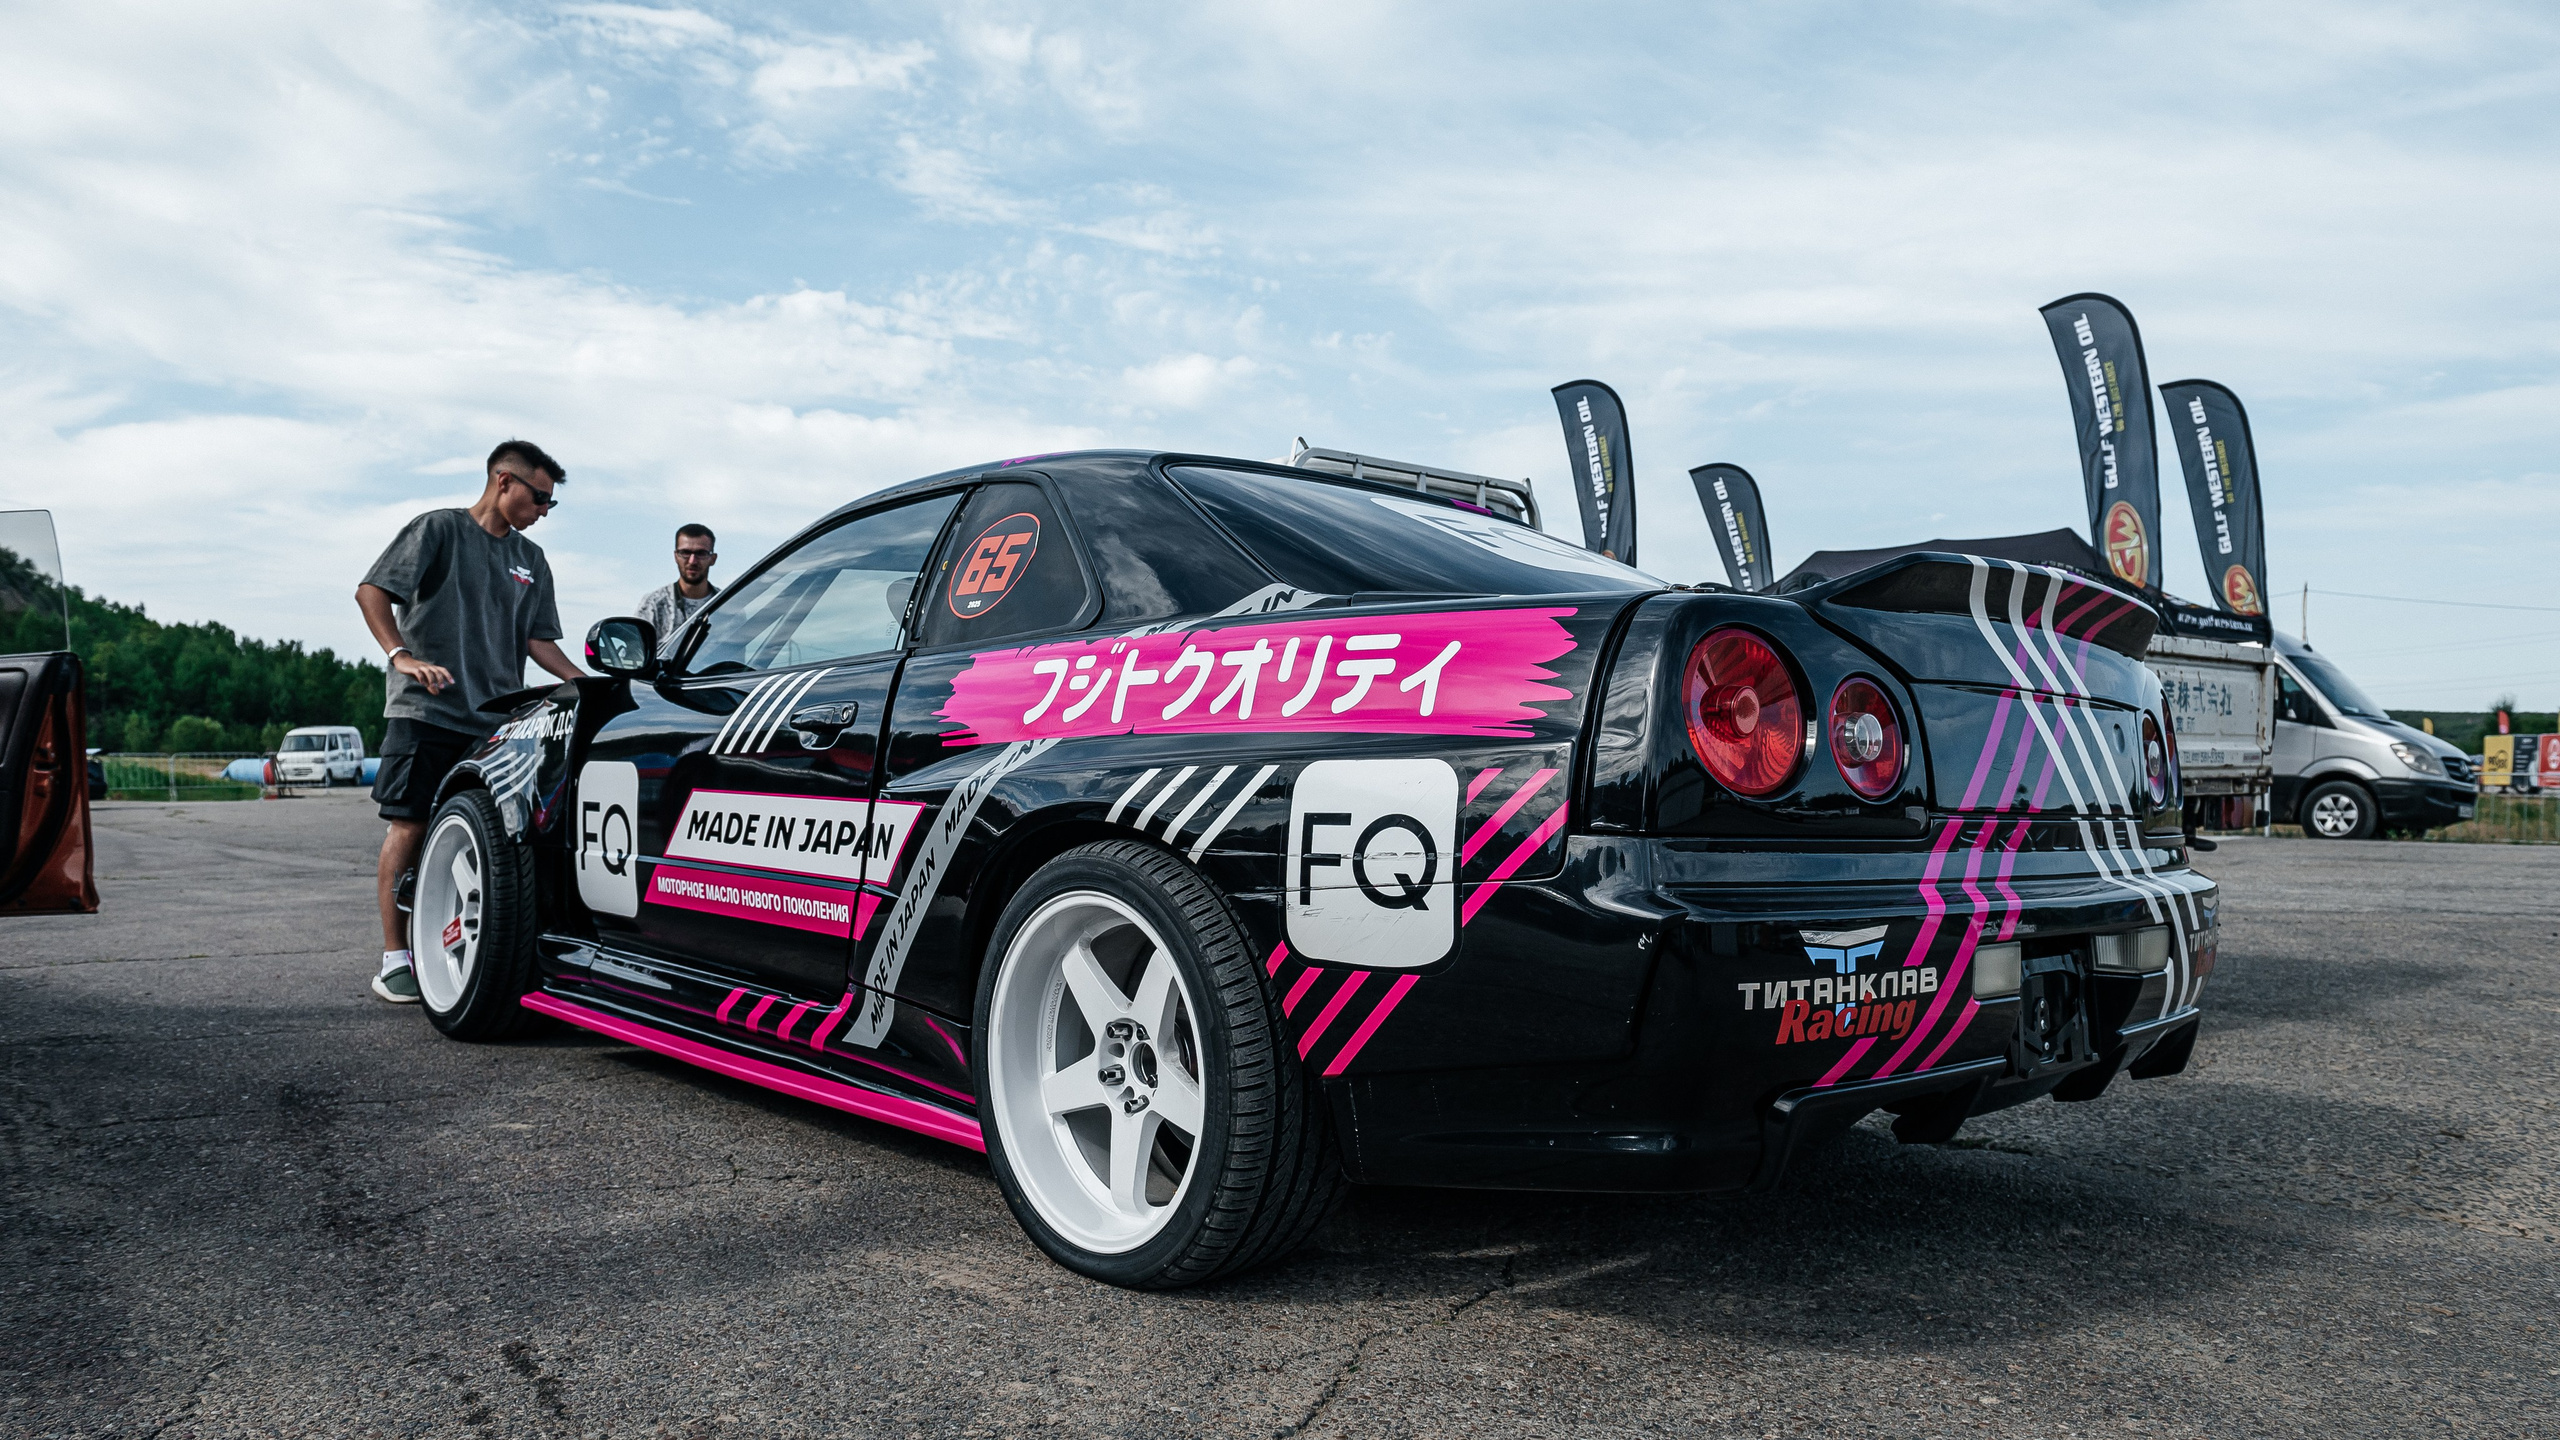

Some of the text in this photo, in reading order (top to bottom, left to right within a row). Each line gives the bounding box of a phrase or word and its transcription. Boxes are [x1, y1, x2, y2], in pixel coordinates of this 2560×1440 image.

[1576, 396, 1592, 423] OIL
[2073, 313, 2118, 489] GULF WESTERN OIL
[1583, 424, 1605, 497] WESTERN
[1712, 477, 1728, 501] OIL
[2188, 396, 2233, 555] GULF WESTERN OIL
[955, 532, 1033, 596] 65
[1720, 501, 1746, 566] WESTERN
[967, 600, 982, 608] 2025
[1023, 634, 1462, 724] フジトクオリティ
[945, 739, 1034, 845] MADE IN
[581, 801, 632, 876] FQ
[687, 810, 895, 860] MADE IN JAPAN
[1300, 812, 1438, 911] FQ
[1960, 829, 2128, 851] SKYLINE
[657, 876, 849, 923] МОТОРНОЕ МАСЛО НОВОГО ПОКОЛЕНИЯ
[871, 847, 936, 1034] MADE IN JAPAN
[1737, 966, 1938, 1010] ТИТАНКЛАВ
[1775, 992, 1917, 1045] Racing
